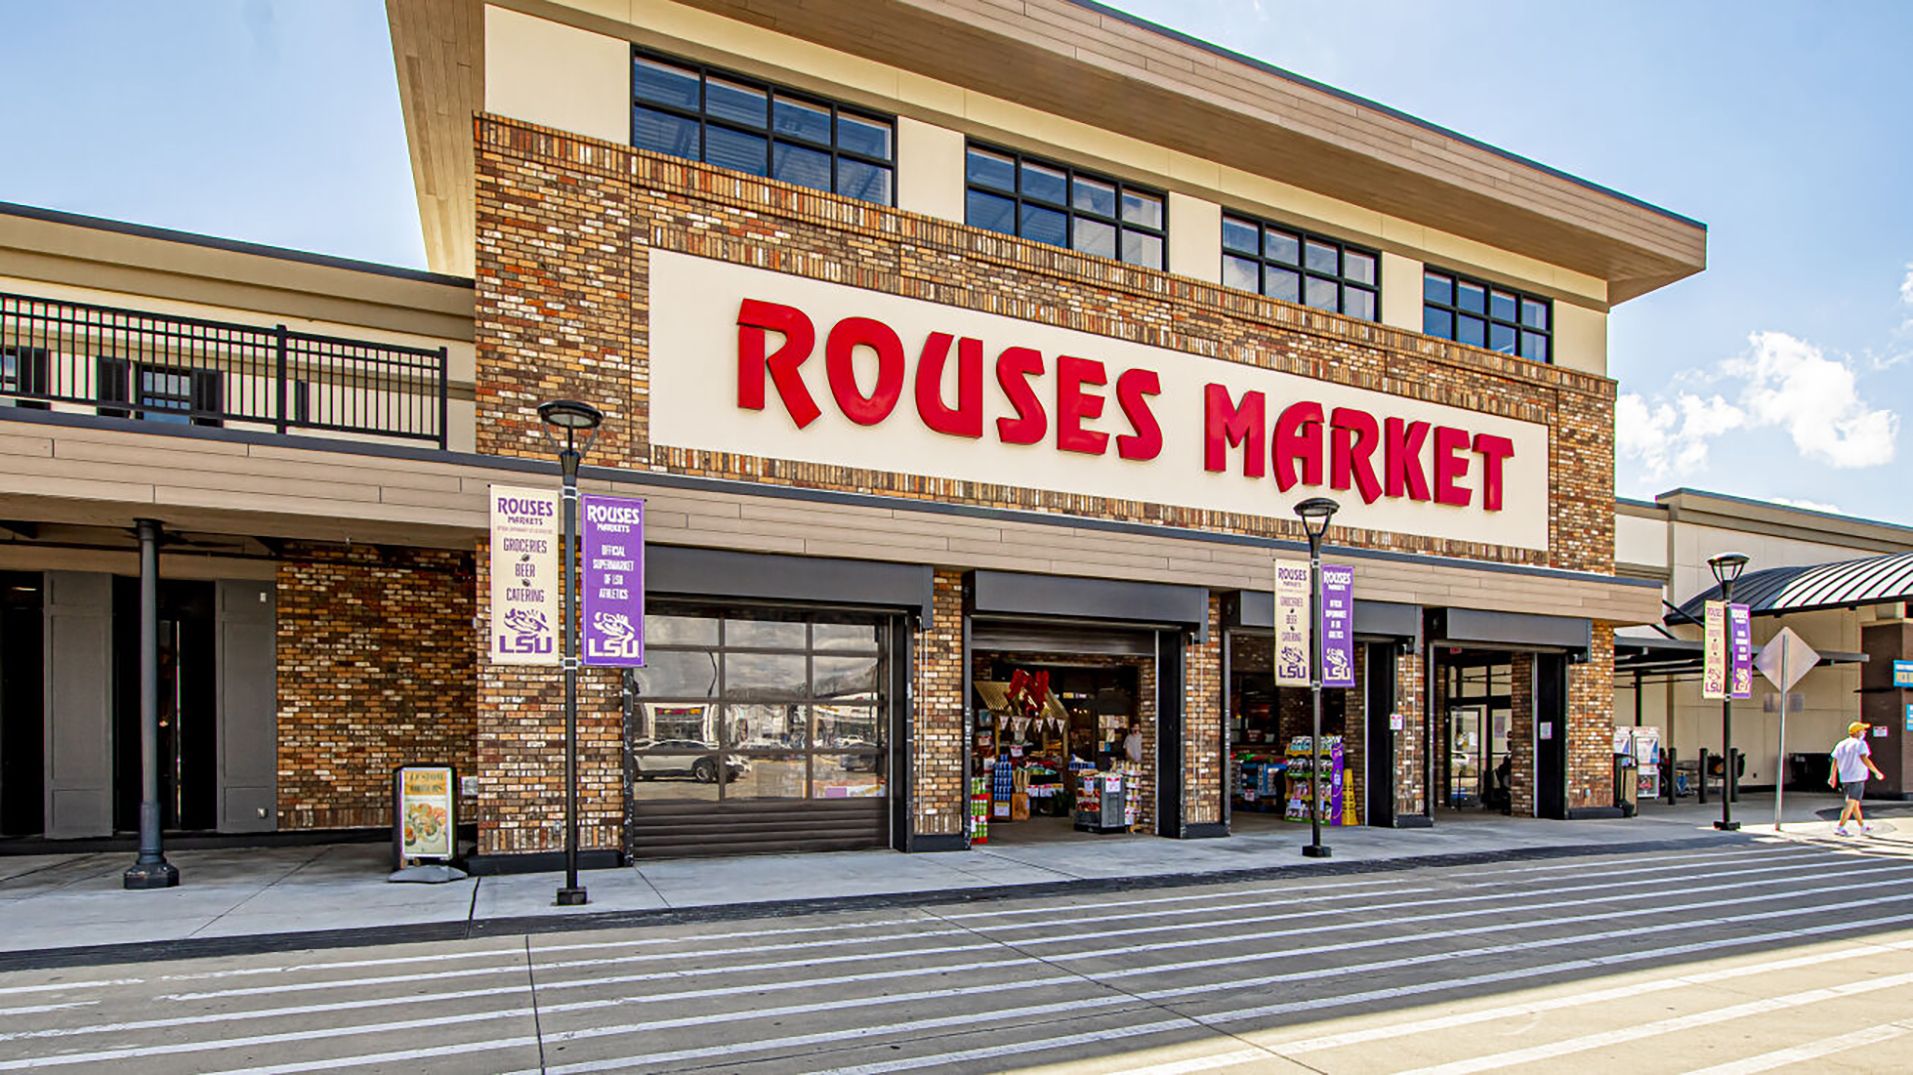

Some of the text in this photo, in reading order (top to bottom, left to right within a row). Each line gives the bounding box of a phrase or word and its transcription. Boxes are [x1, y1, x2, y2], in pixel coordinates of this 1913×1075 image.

[736, 298, 1515, 511] ROUSES MARKET
[497, 497, 554, 517] ROUSES
[586, 504, 641, 525] ROUSES
[507, 515, 543, 526] MARKETS
[596, 523, 631, 534] MARKETS
[503, 537, 547, 553] GROCERIES
[515, 563, 536, 578] BEER
[1278, 567, 1307, 581] ROUSES
[506, 587, 545, 603] CATERING
[499, 635, 553, 654] LSU
[588, 638, 640, 659] LSU
[1278, 665, 1306, 679] LSU
[1324, 667, 1351, 680] LSU
